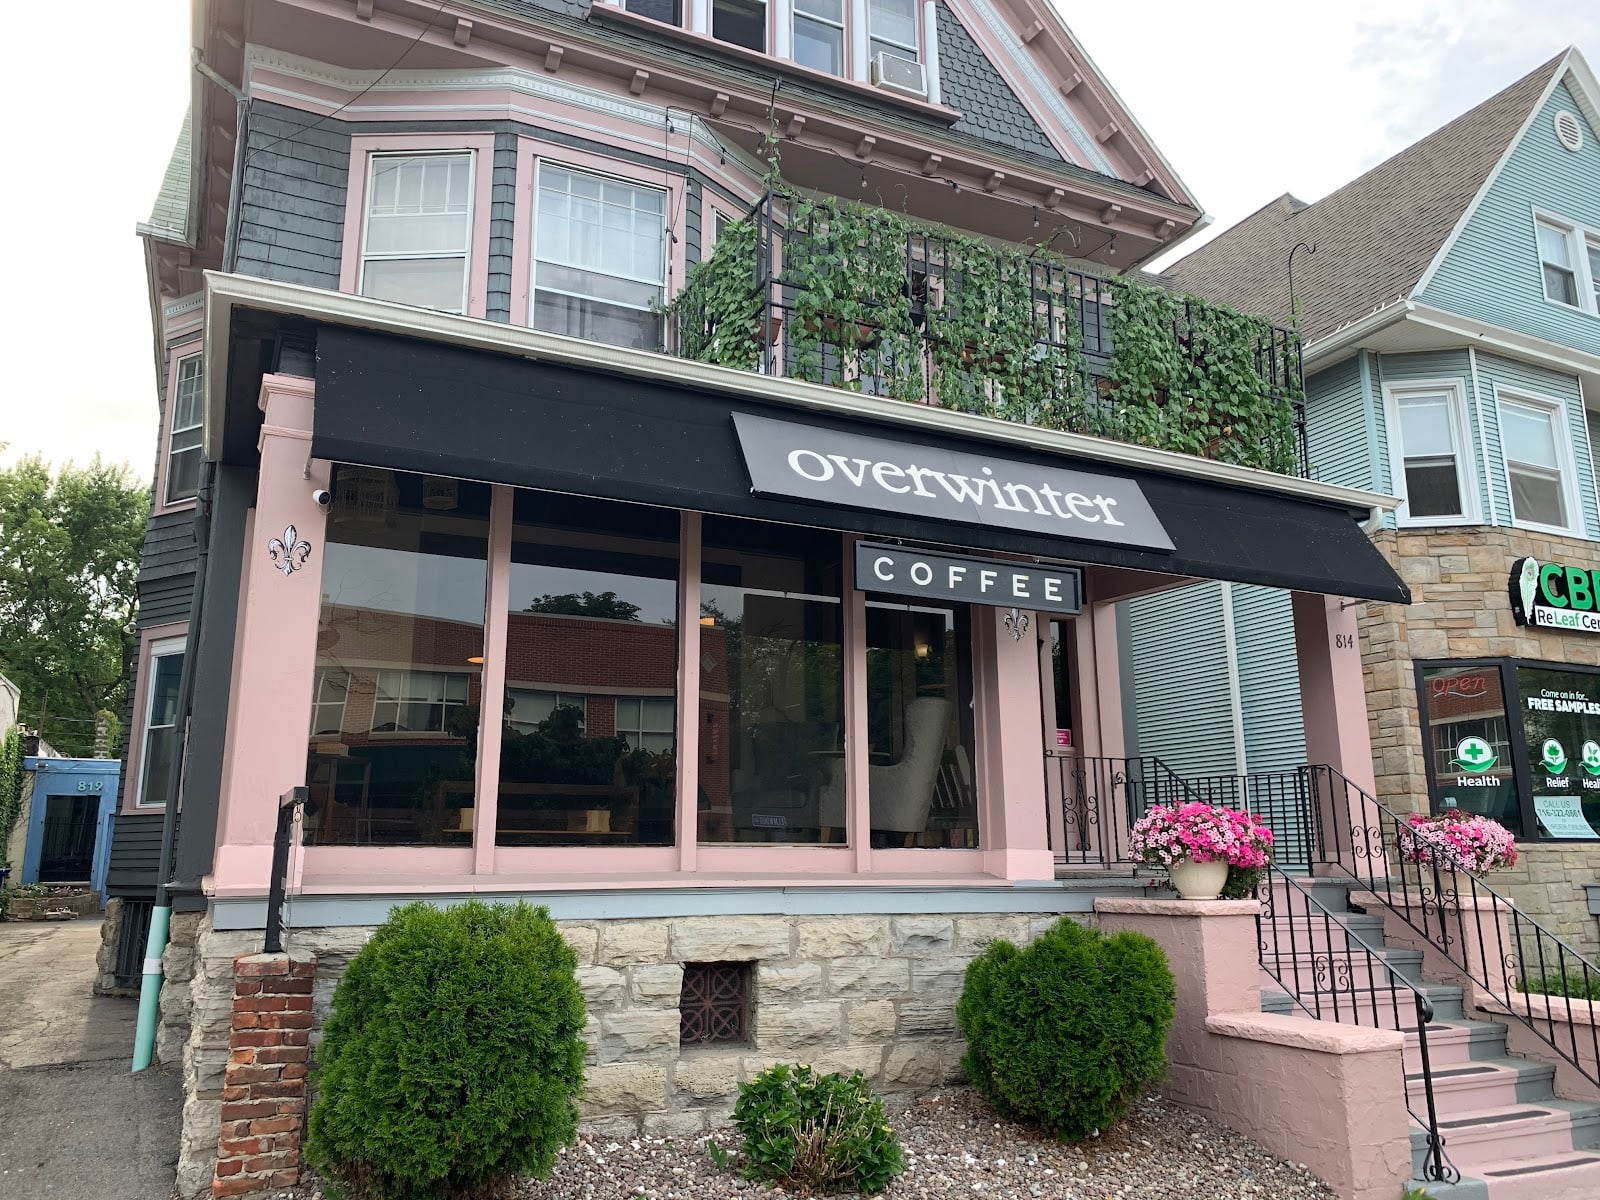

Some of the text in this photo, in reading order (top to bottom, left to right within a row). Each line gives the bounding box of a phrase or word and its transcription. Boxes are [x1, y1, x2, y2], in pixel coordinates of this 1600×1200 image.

[788, 449, 1125, 526] overwinter
[873, 556, 1063, 601] COFFEE
[1537, 609, 1580, 627] ReLeaf
[1336, 634, 1353, 649] 814
[1540, 688, 1559, 698] Come
[1560, 691, 1568, 699] on
[1569, 690, 1575, 699] in
[1527, 697, 1600, 715] FREE SAMPLES
[1457, 776, 1501, 787] Health
[1546, 776, 1569, 788] Relief
[1561, 800, 1571, 808] US
